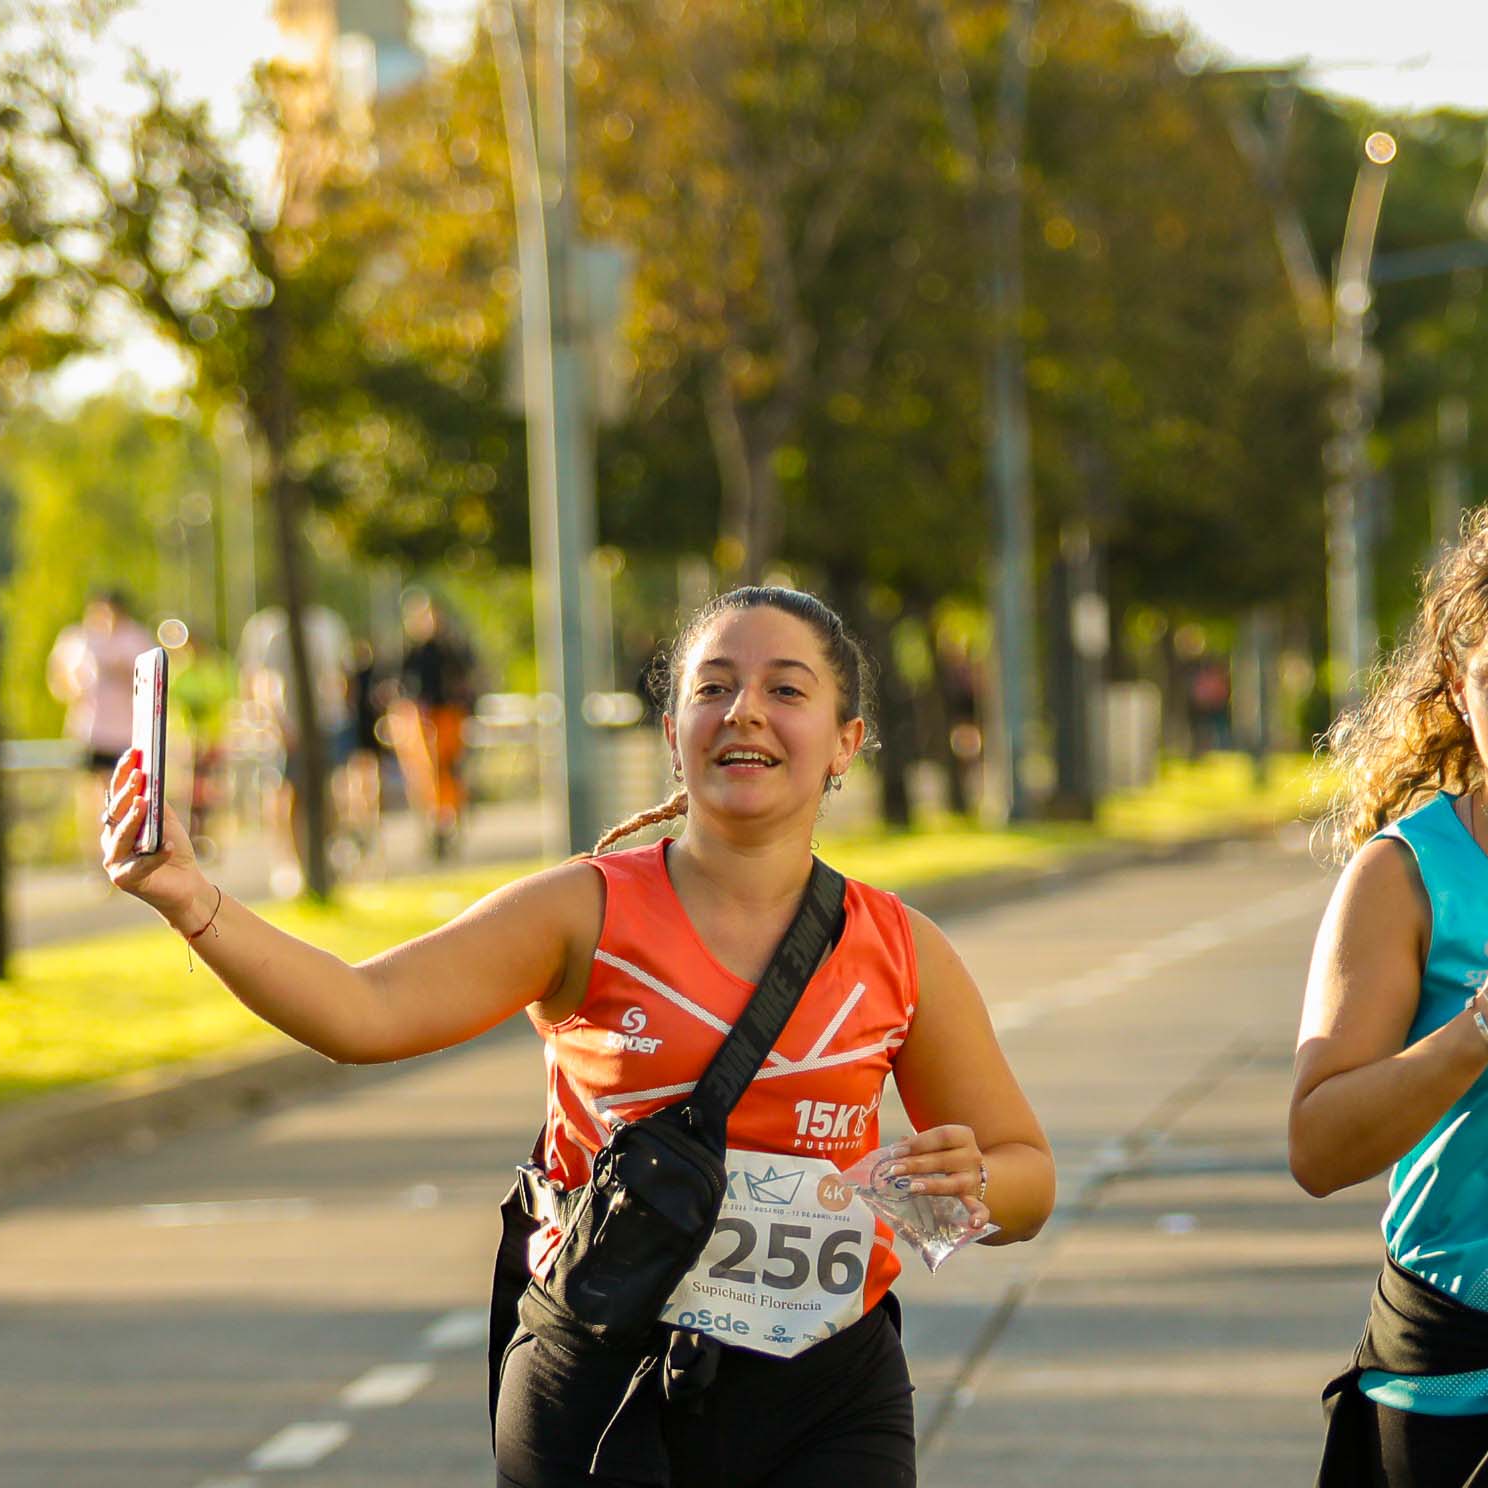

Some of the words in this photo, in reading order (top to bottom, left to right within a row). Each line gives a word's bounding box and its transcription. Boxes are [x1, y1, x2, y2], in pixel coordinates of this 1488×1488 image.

[794, 1099, 860, 1138] 15K
[823, 1184, 845, 1201] 4K
[689, 1217, 864, 1295] 256
[692, 1281, 756, 1305] Supichatti
[760, 1294, 822, 1311] Florencia
[678, 1308, 750, 1335] osde
